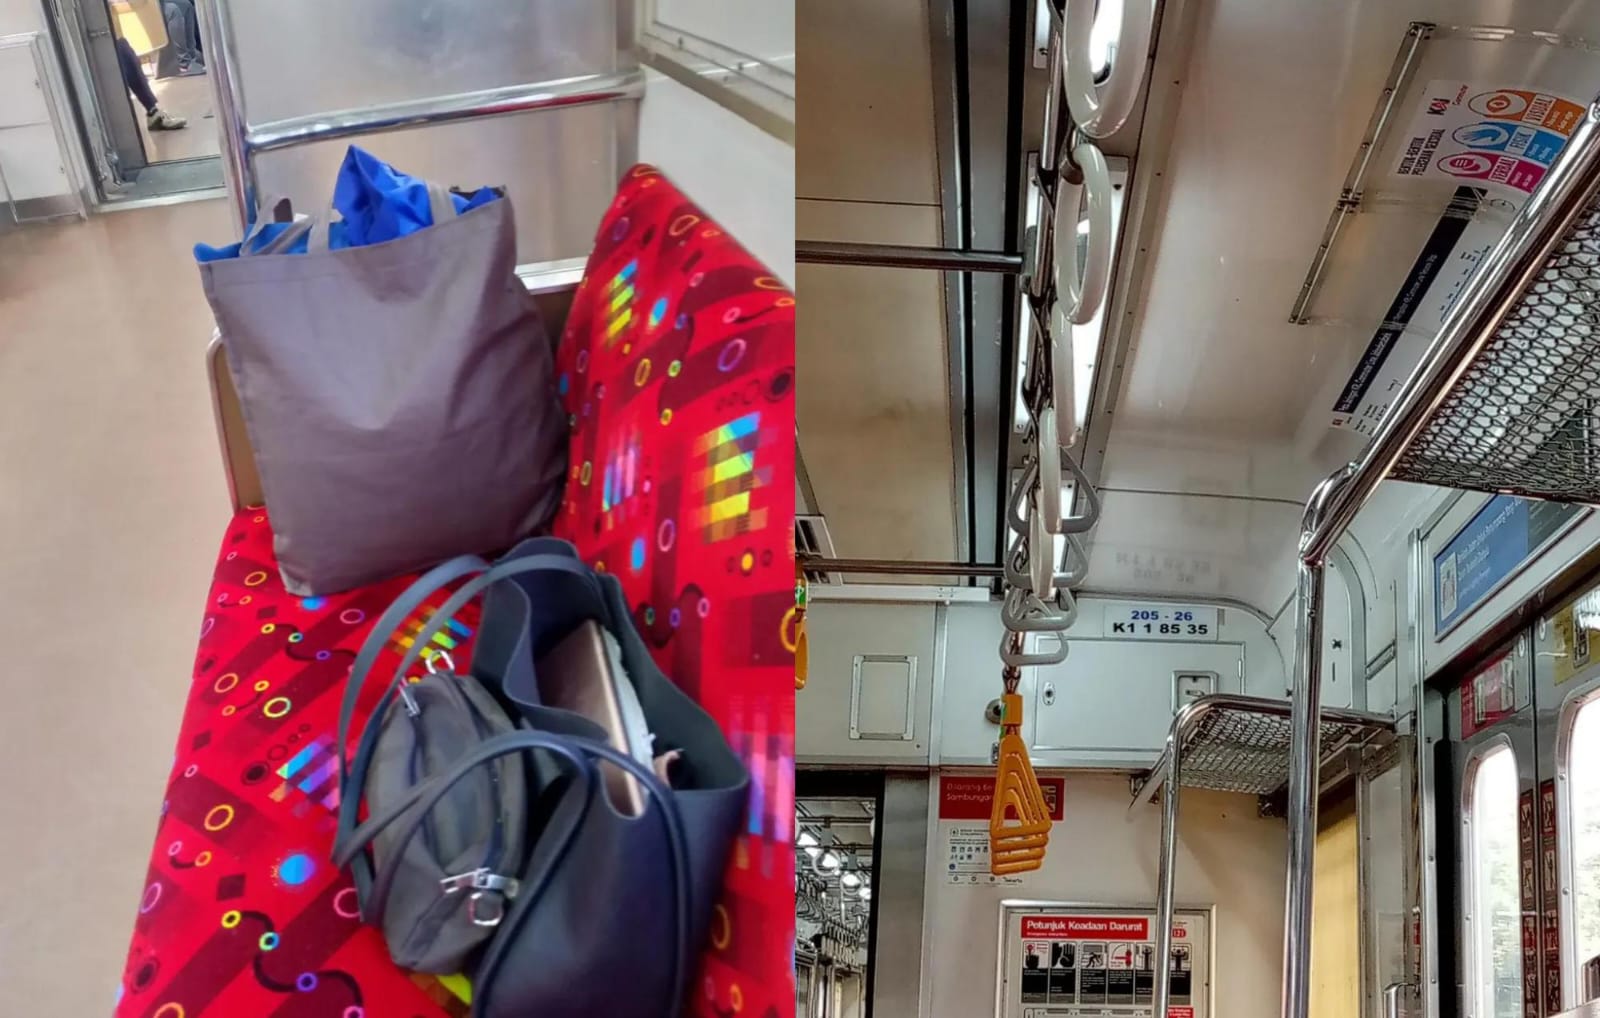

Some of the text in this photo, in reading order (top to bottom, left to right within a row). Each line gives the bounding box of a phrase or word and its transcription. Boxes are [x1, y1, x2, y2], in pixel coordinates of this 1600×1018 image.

[1131, 610, 1159, 620] 205
[1174, 611, 1193, 621] 26
[1113, 622, 1208, 635] K1 1 85 35
[1026, 920, 1143, 932] Petunjuk Keadaan Darurat
